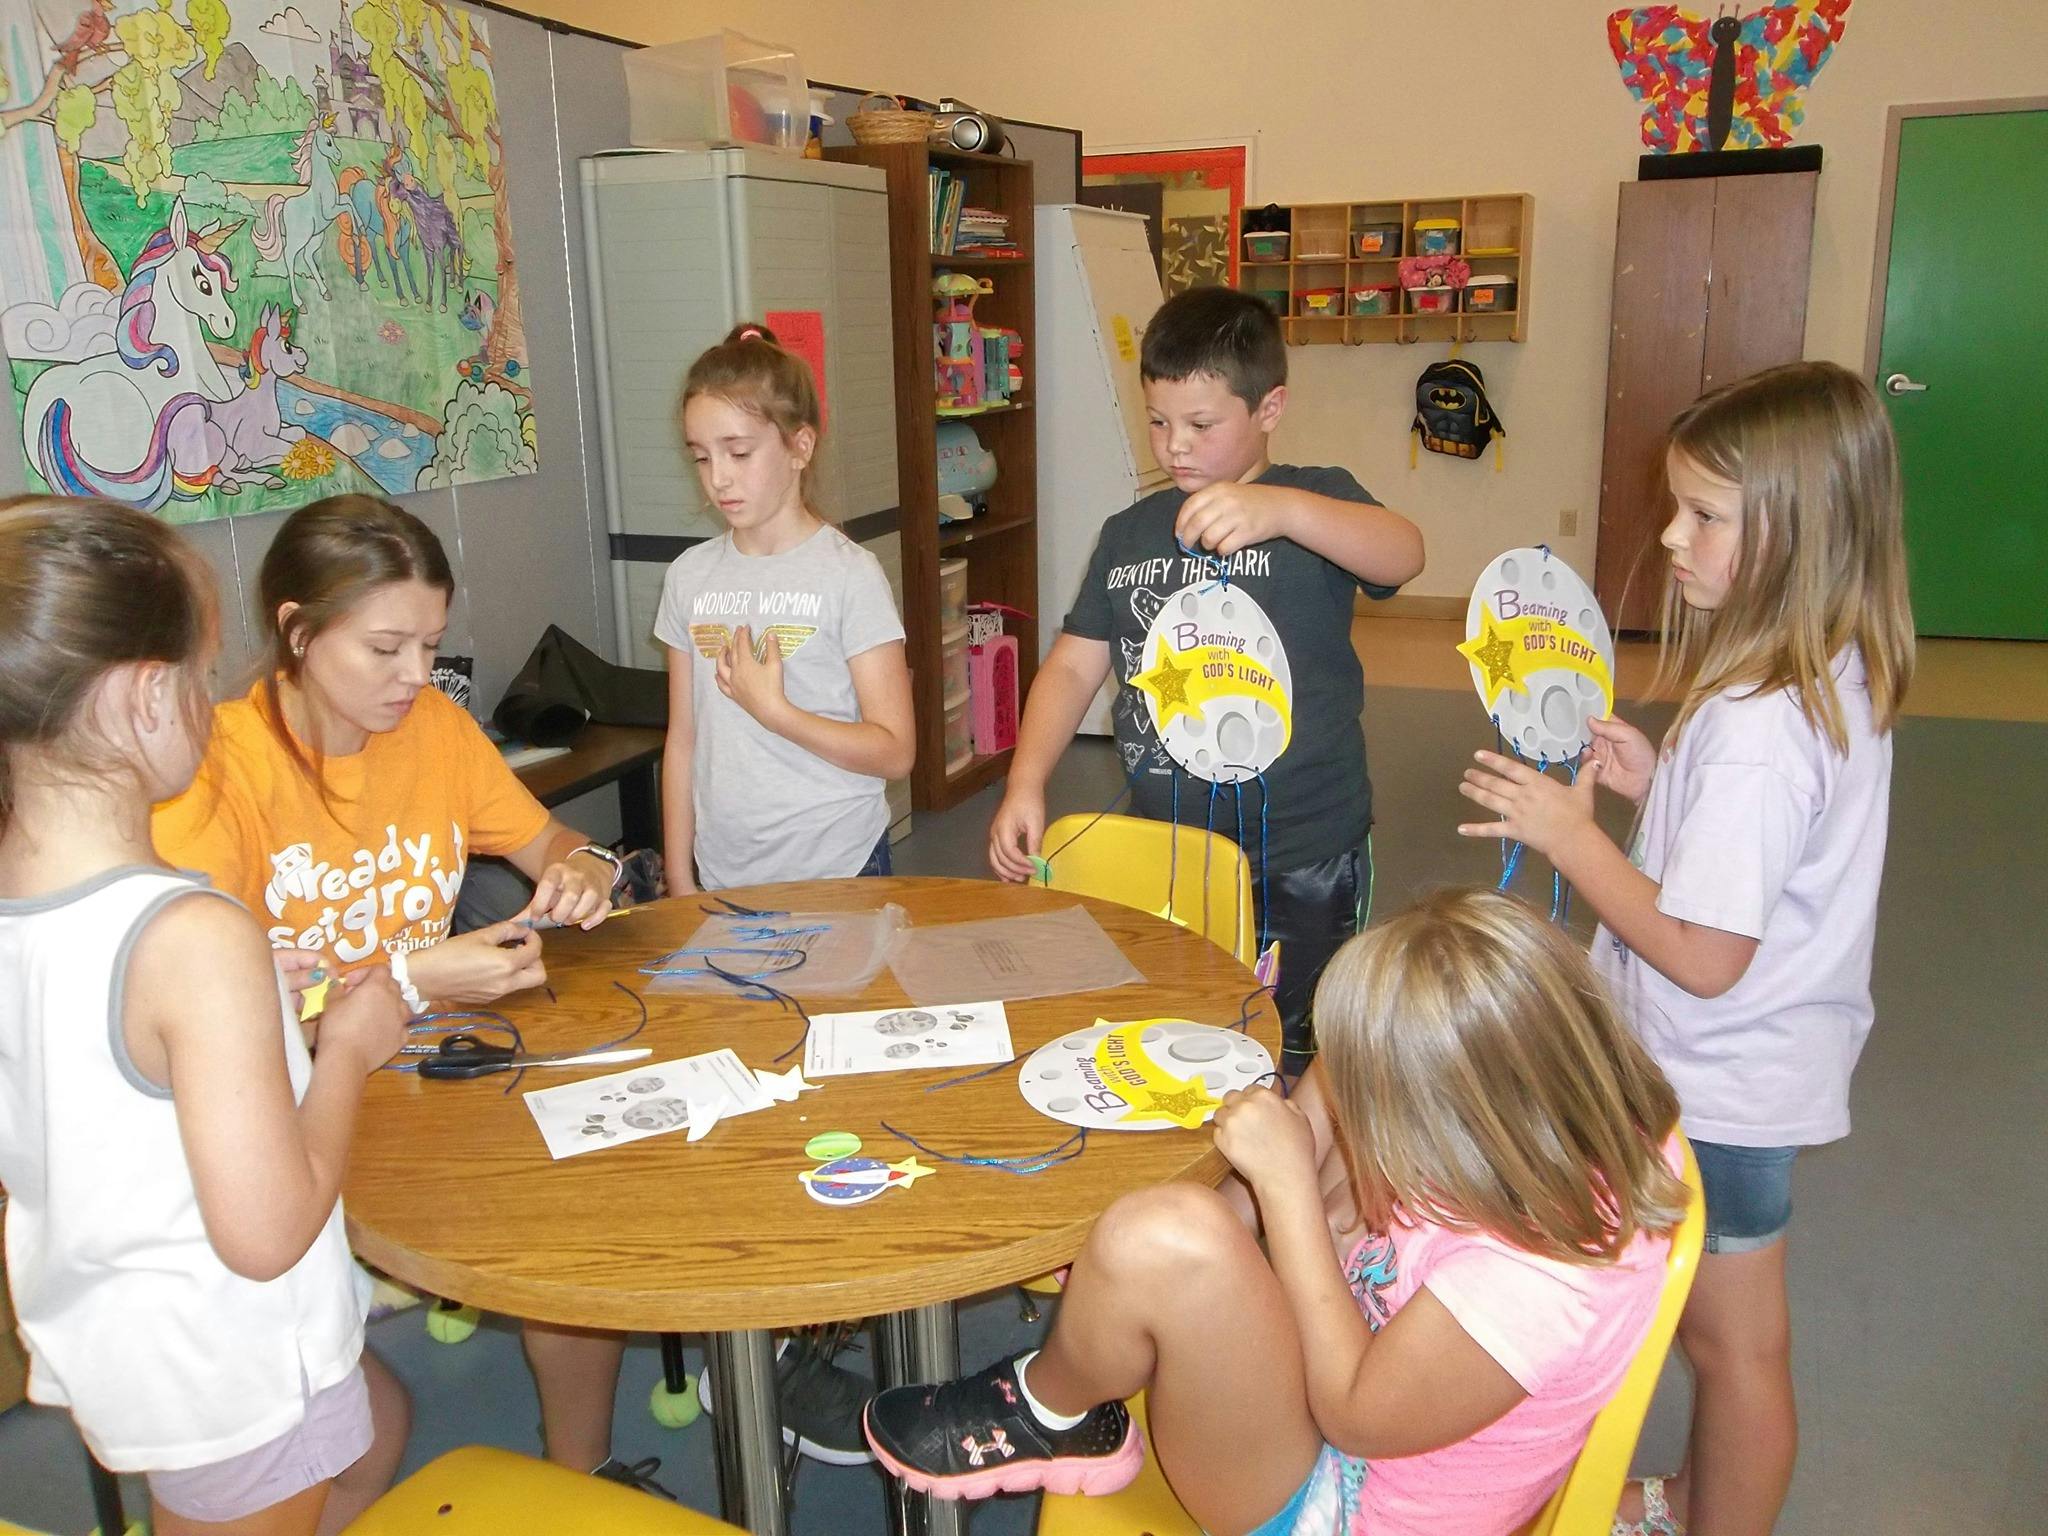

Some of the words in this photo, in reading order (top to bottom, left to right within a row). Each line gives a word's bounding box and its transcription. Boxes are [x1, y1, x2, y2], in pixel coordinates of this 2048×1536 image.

[1107, 558, 1174, 590] IDENTIFY
[1181, 555, 1213, 585] THE
[693, 591, 752, 616] WONDER
[759, 591, 822, 617] WOMAN
[1493, 590, 1568, 626] Beaming
[1172, 622, 1247, 654] Beaming
[1528, 619, 1552, 633] with
[1207, 648, 1230, 661] with
[1523, 634, 1557, 651] GOD'S
[1560, 638, 1598, 665] LIGHT
[1203, 662, 1234, 679] GOD'S
[1239, 665, 1276, 692] LIGHT
[1107, 1033, 1126, 1058] LIGHT
[1075, 1056, 1128, 1114] Beaming
[1112, 1060, 1147, 1086] GOD'S
